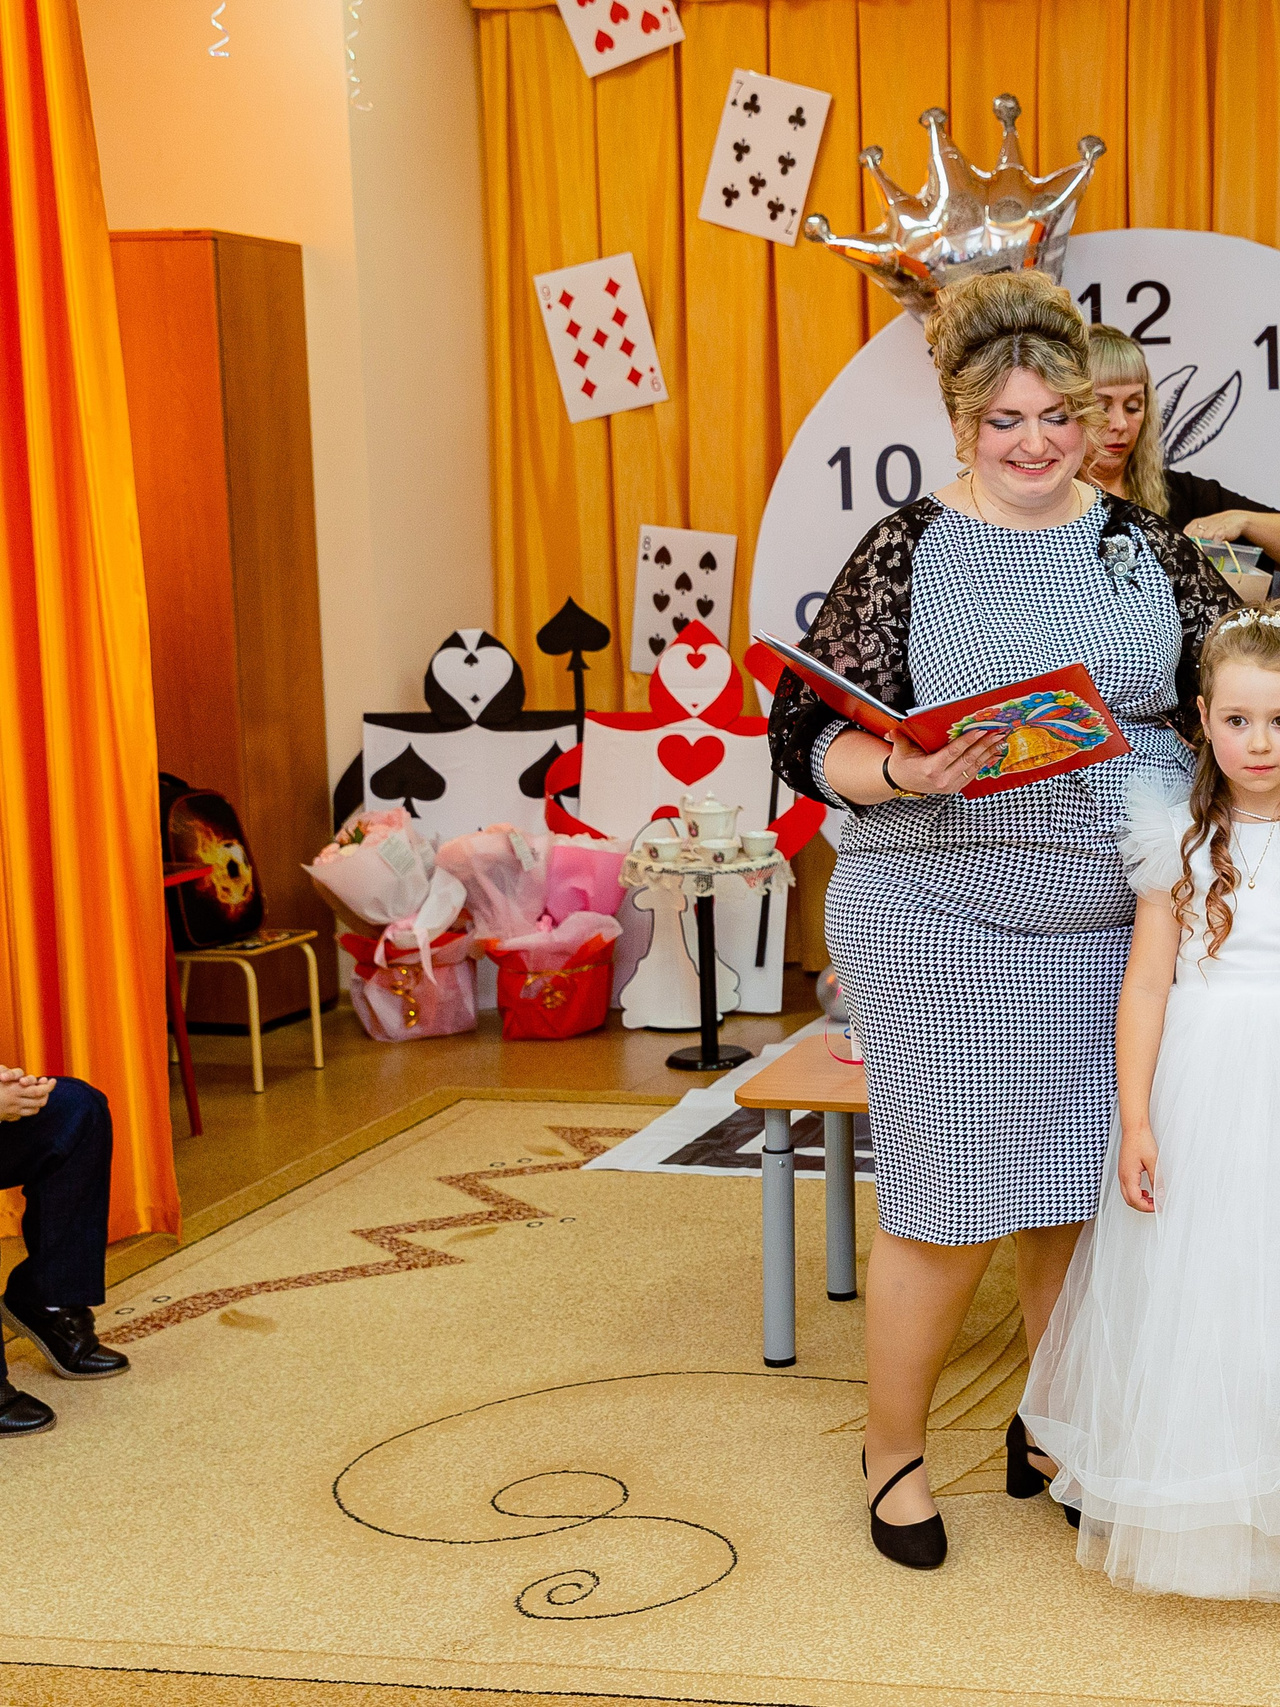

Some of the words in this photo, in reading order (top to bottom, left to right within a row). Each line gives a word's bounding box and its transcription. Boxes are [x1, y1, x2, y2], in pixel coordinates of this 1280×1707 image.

[735, 79, 745, 97] 7
[541, 284, 552, 301] 9
[1077, 280, 1171, 345] 12
[1254, 325, 1280, 391] 1
[650, 376, 662, 393] 9
[827, 443, 922, 511] 10
[643, 534, 652, 551] 8
